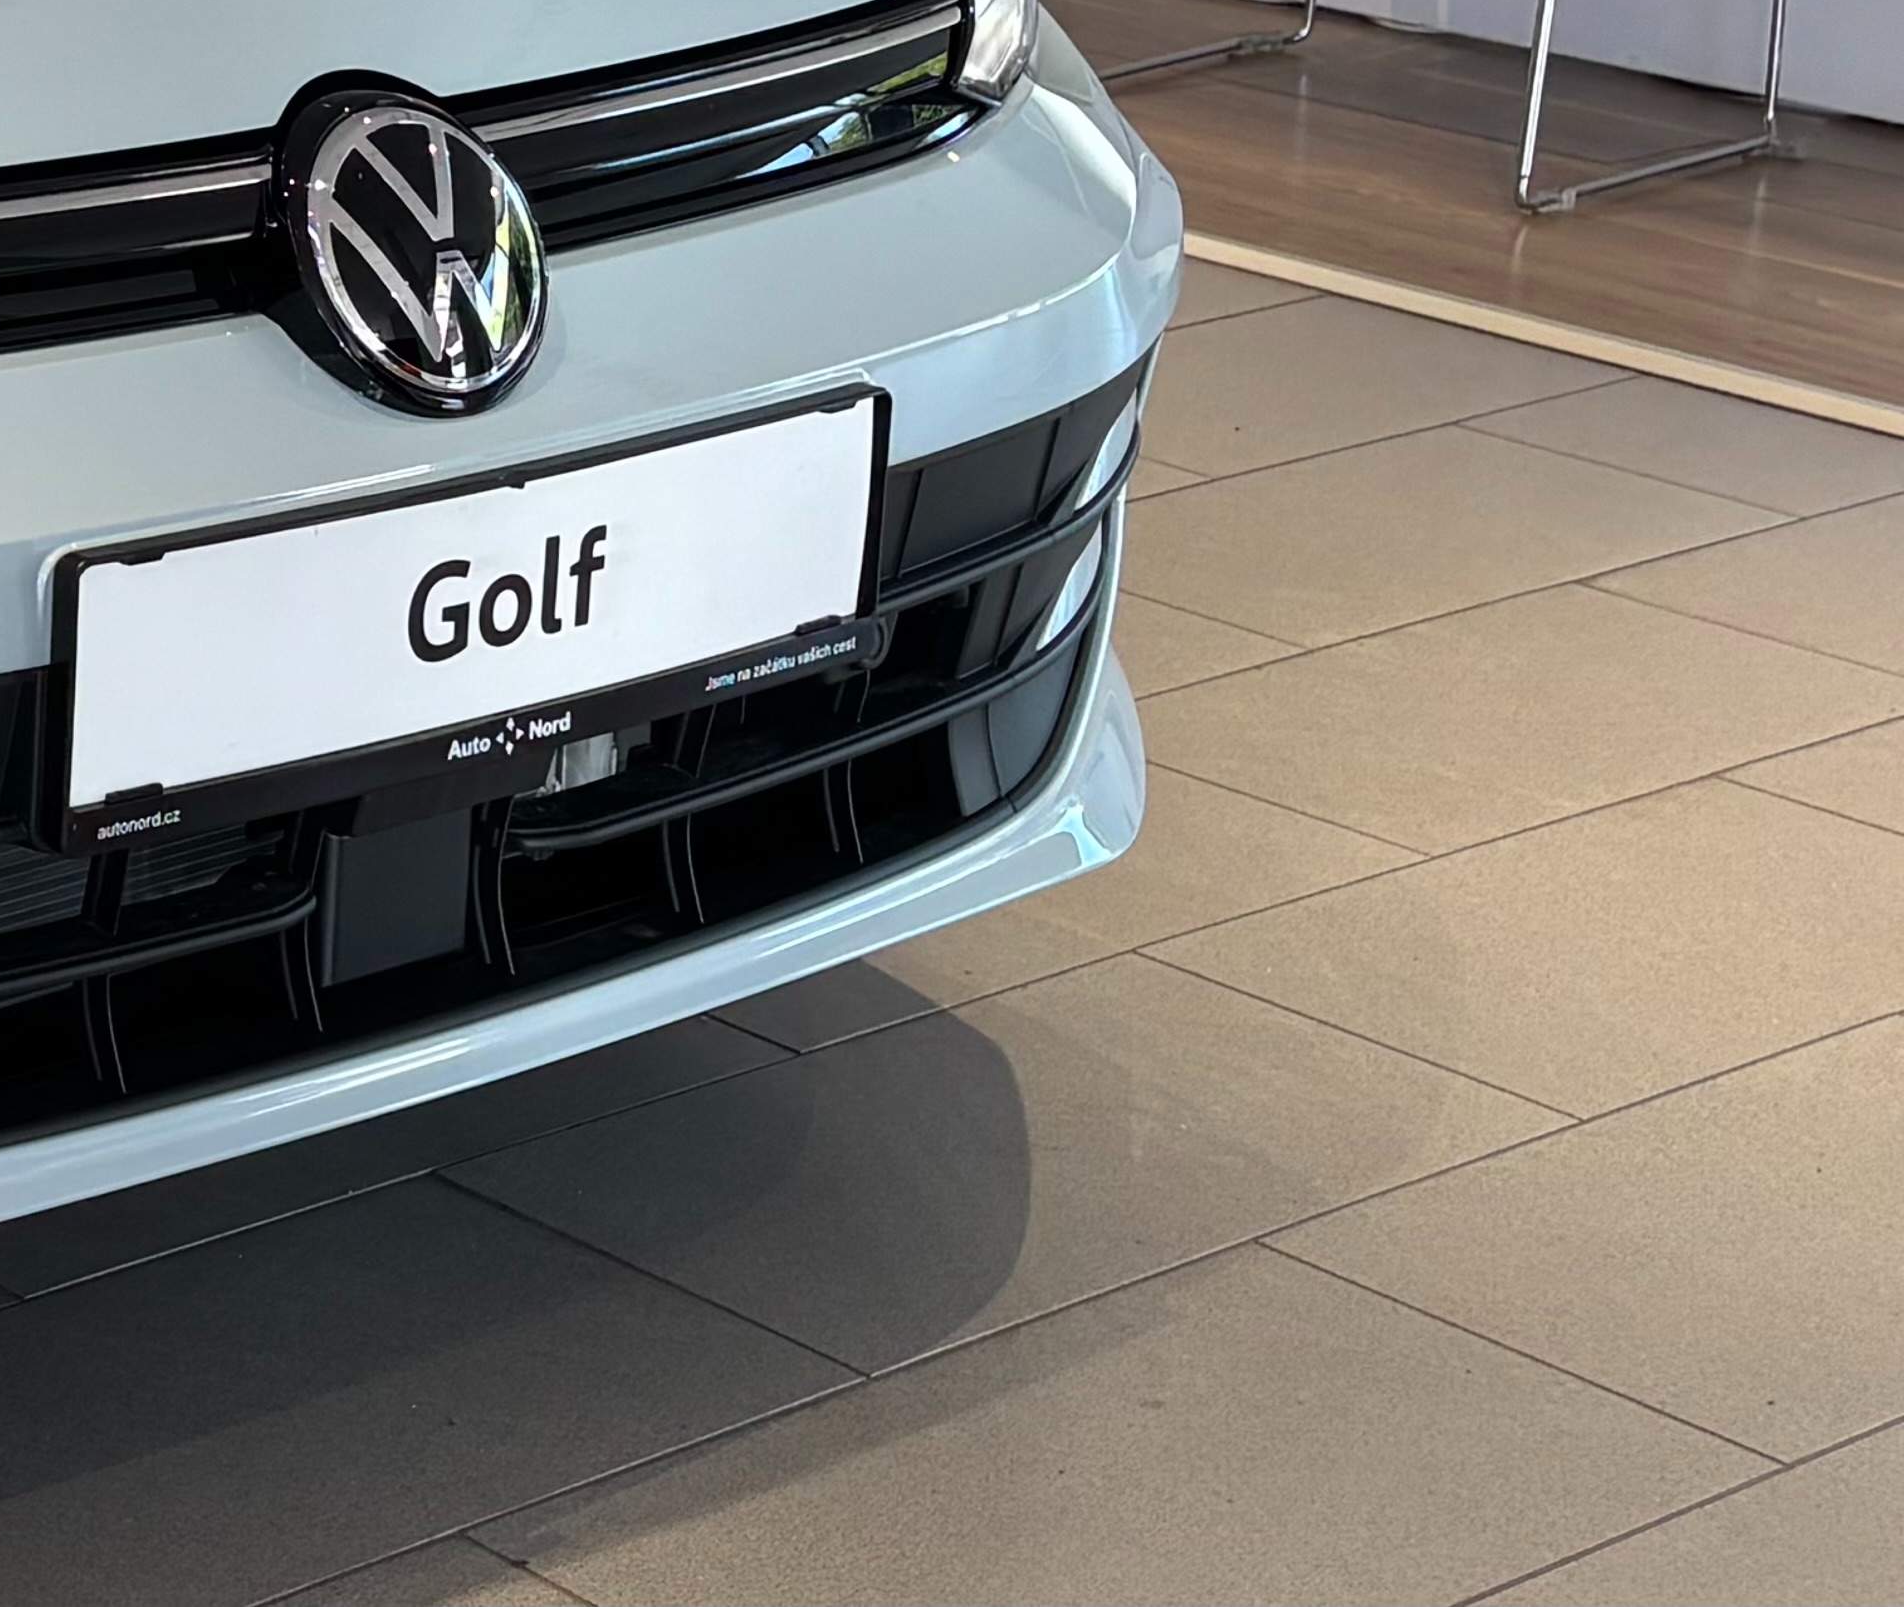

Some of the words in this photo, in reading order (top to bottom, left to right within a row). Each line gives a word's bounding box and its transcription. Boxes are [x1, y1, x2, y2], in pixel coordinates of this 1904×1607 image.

[408, 524, 607, 663] Golf
[705, 672, 735, 691] Jsme
[737, 669, 751, 682] na
[753, 656, 796, 678] začátku
[798, 644, 831, 665] vašich
[833, 636, 856, 655] cest
[447, 736, 491, 760] Auto
[529, 711, 571, 740] Nord
[97, 809, 181, 841] autonord.cz
